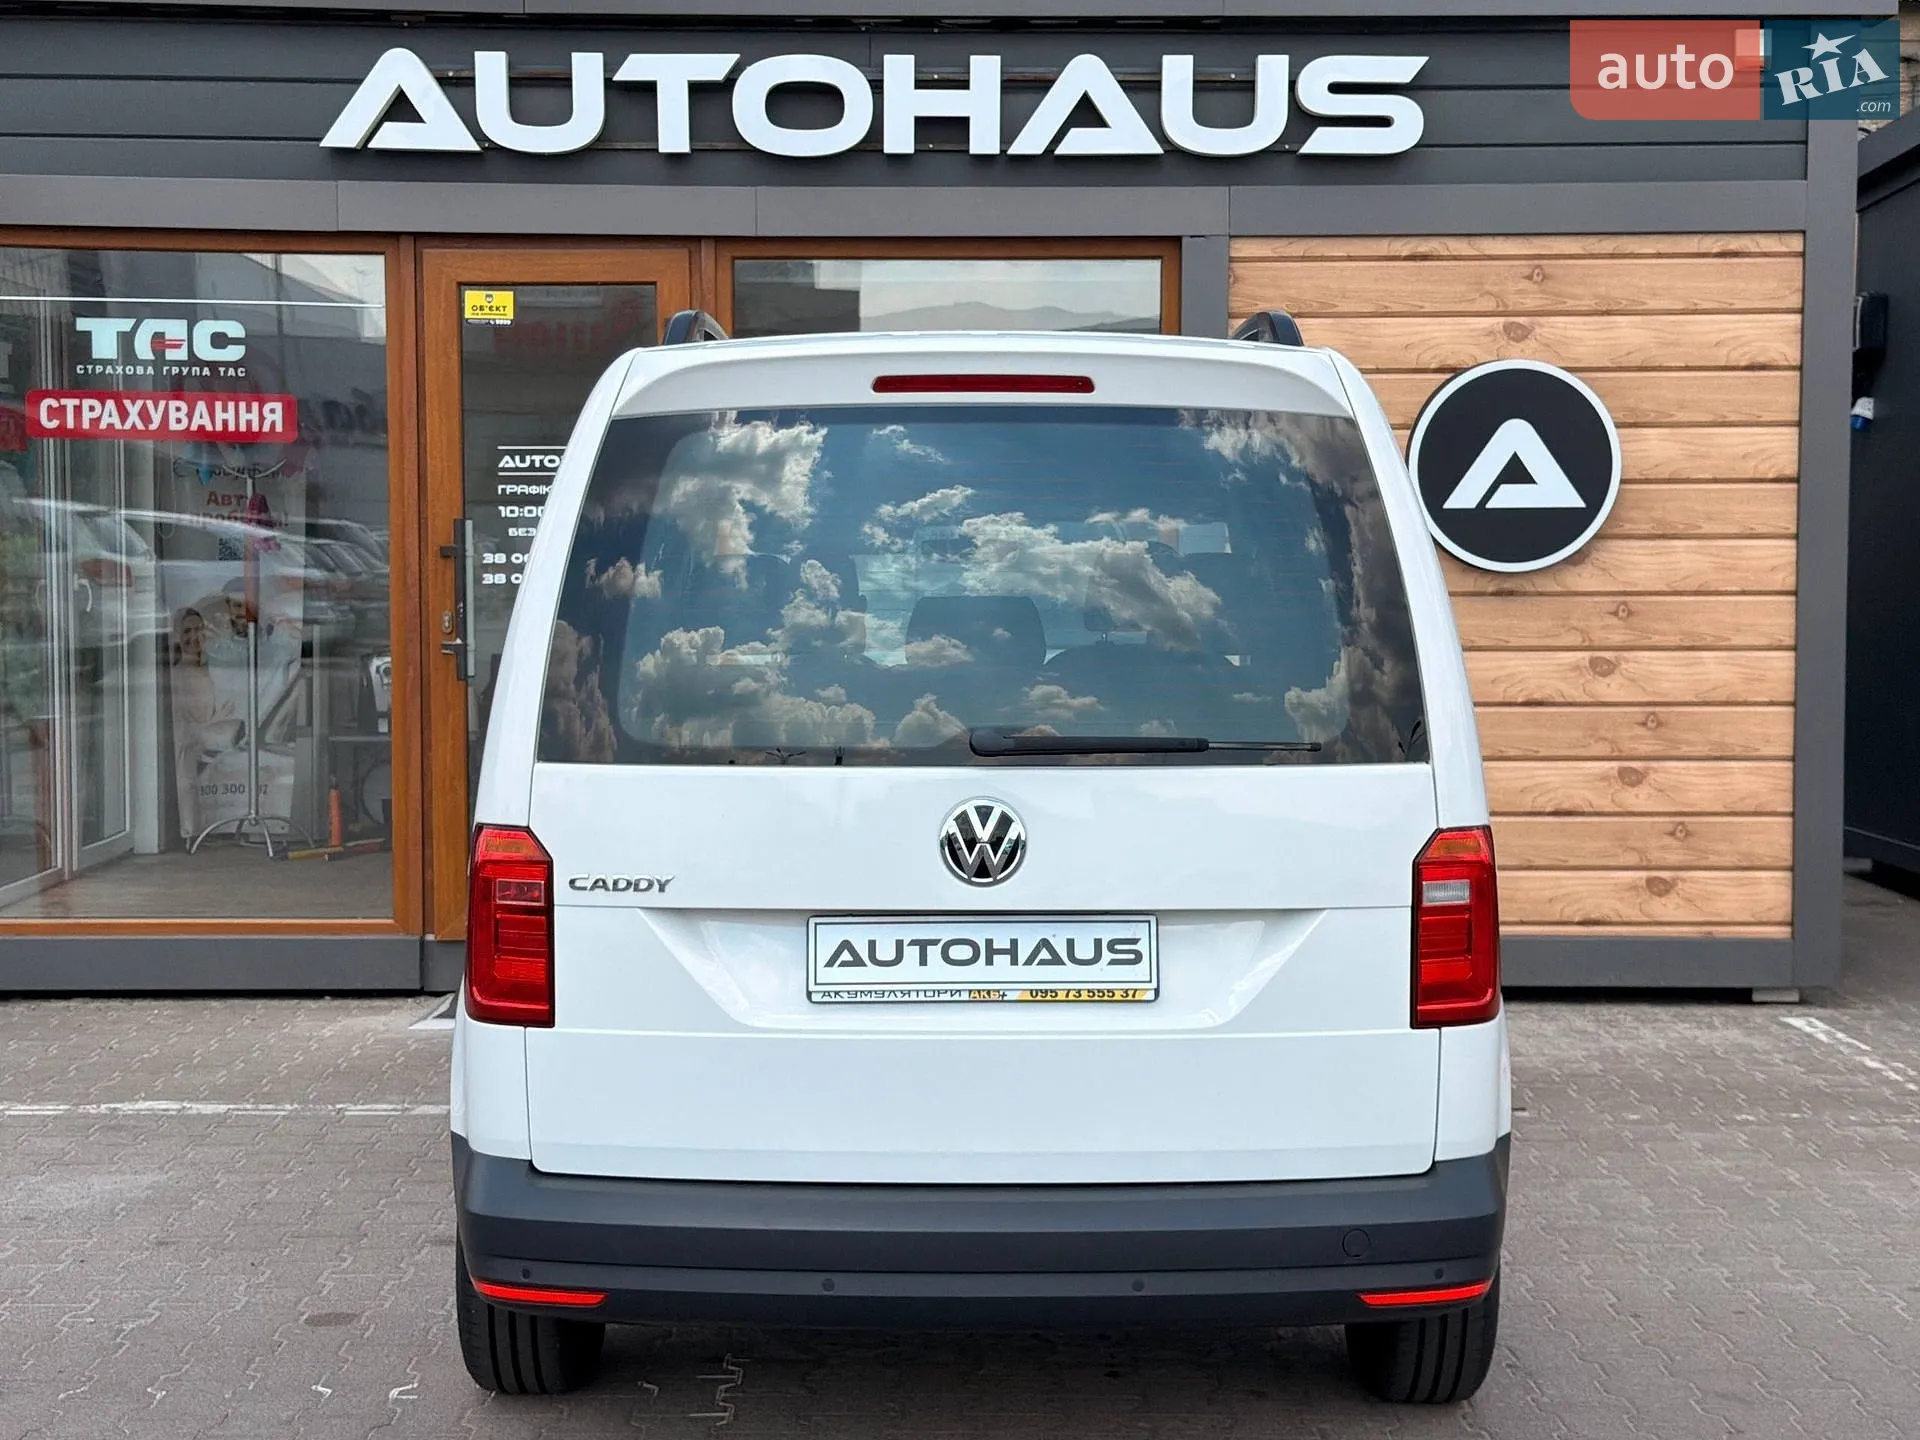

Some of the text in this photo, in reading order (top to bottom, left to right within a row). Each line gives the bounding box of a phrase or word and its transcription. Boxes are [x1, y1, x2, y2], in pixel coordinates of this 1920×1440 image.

[320, 47, 1430, 158] AUTOHAUS
[76, 365, 246, 377] СТРАХОВА ГРУПА ТАС
[38, 398, 284, 433] СТРАХУВАННЯ
[498, 455, 564, 468] AUTO
[482, 553, 507, 564] 38
[482, 573, 507, 584] 38
[568, 874, 675, 893] CADDY
[823, 938, 1143, 968] AUTOHAUS
